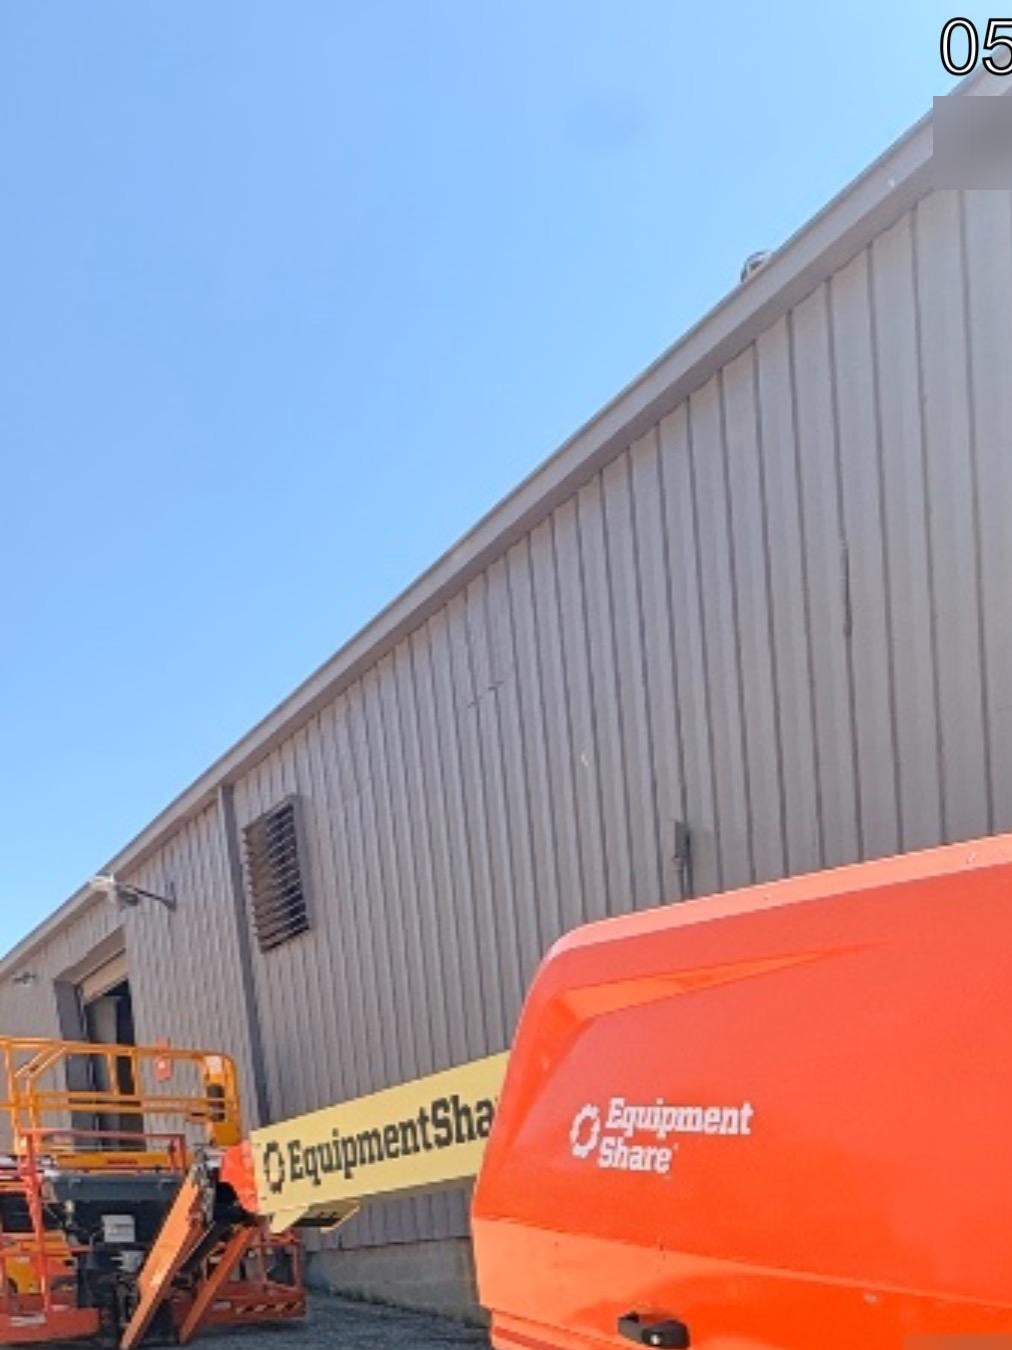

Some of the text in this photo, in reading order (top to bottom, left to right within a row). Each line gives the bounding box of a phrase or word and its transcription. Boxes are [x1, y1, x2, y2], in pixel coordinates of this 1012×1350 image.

[287, 1094, 498, 1186] EquipmentSha
[604, 1096, 754, 1140] Equipment
[598, 1136, 672, 1174] Share
